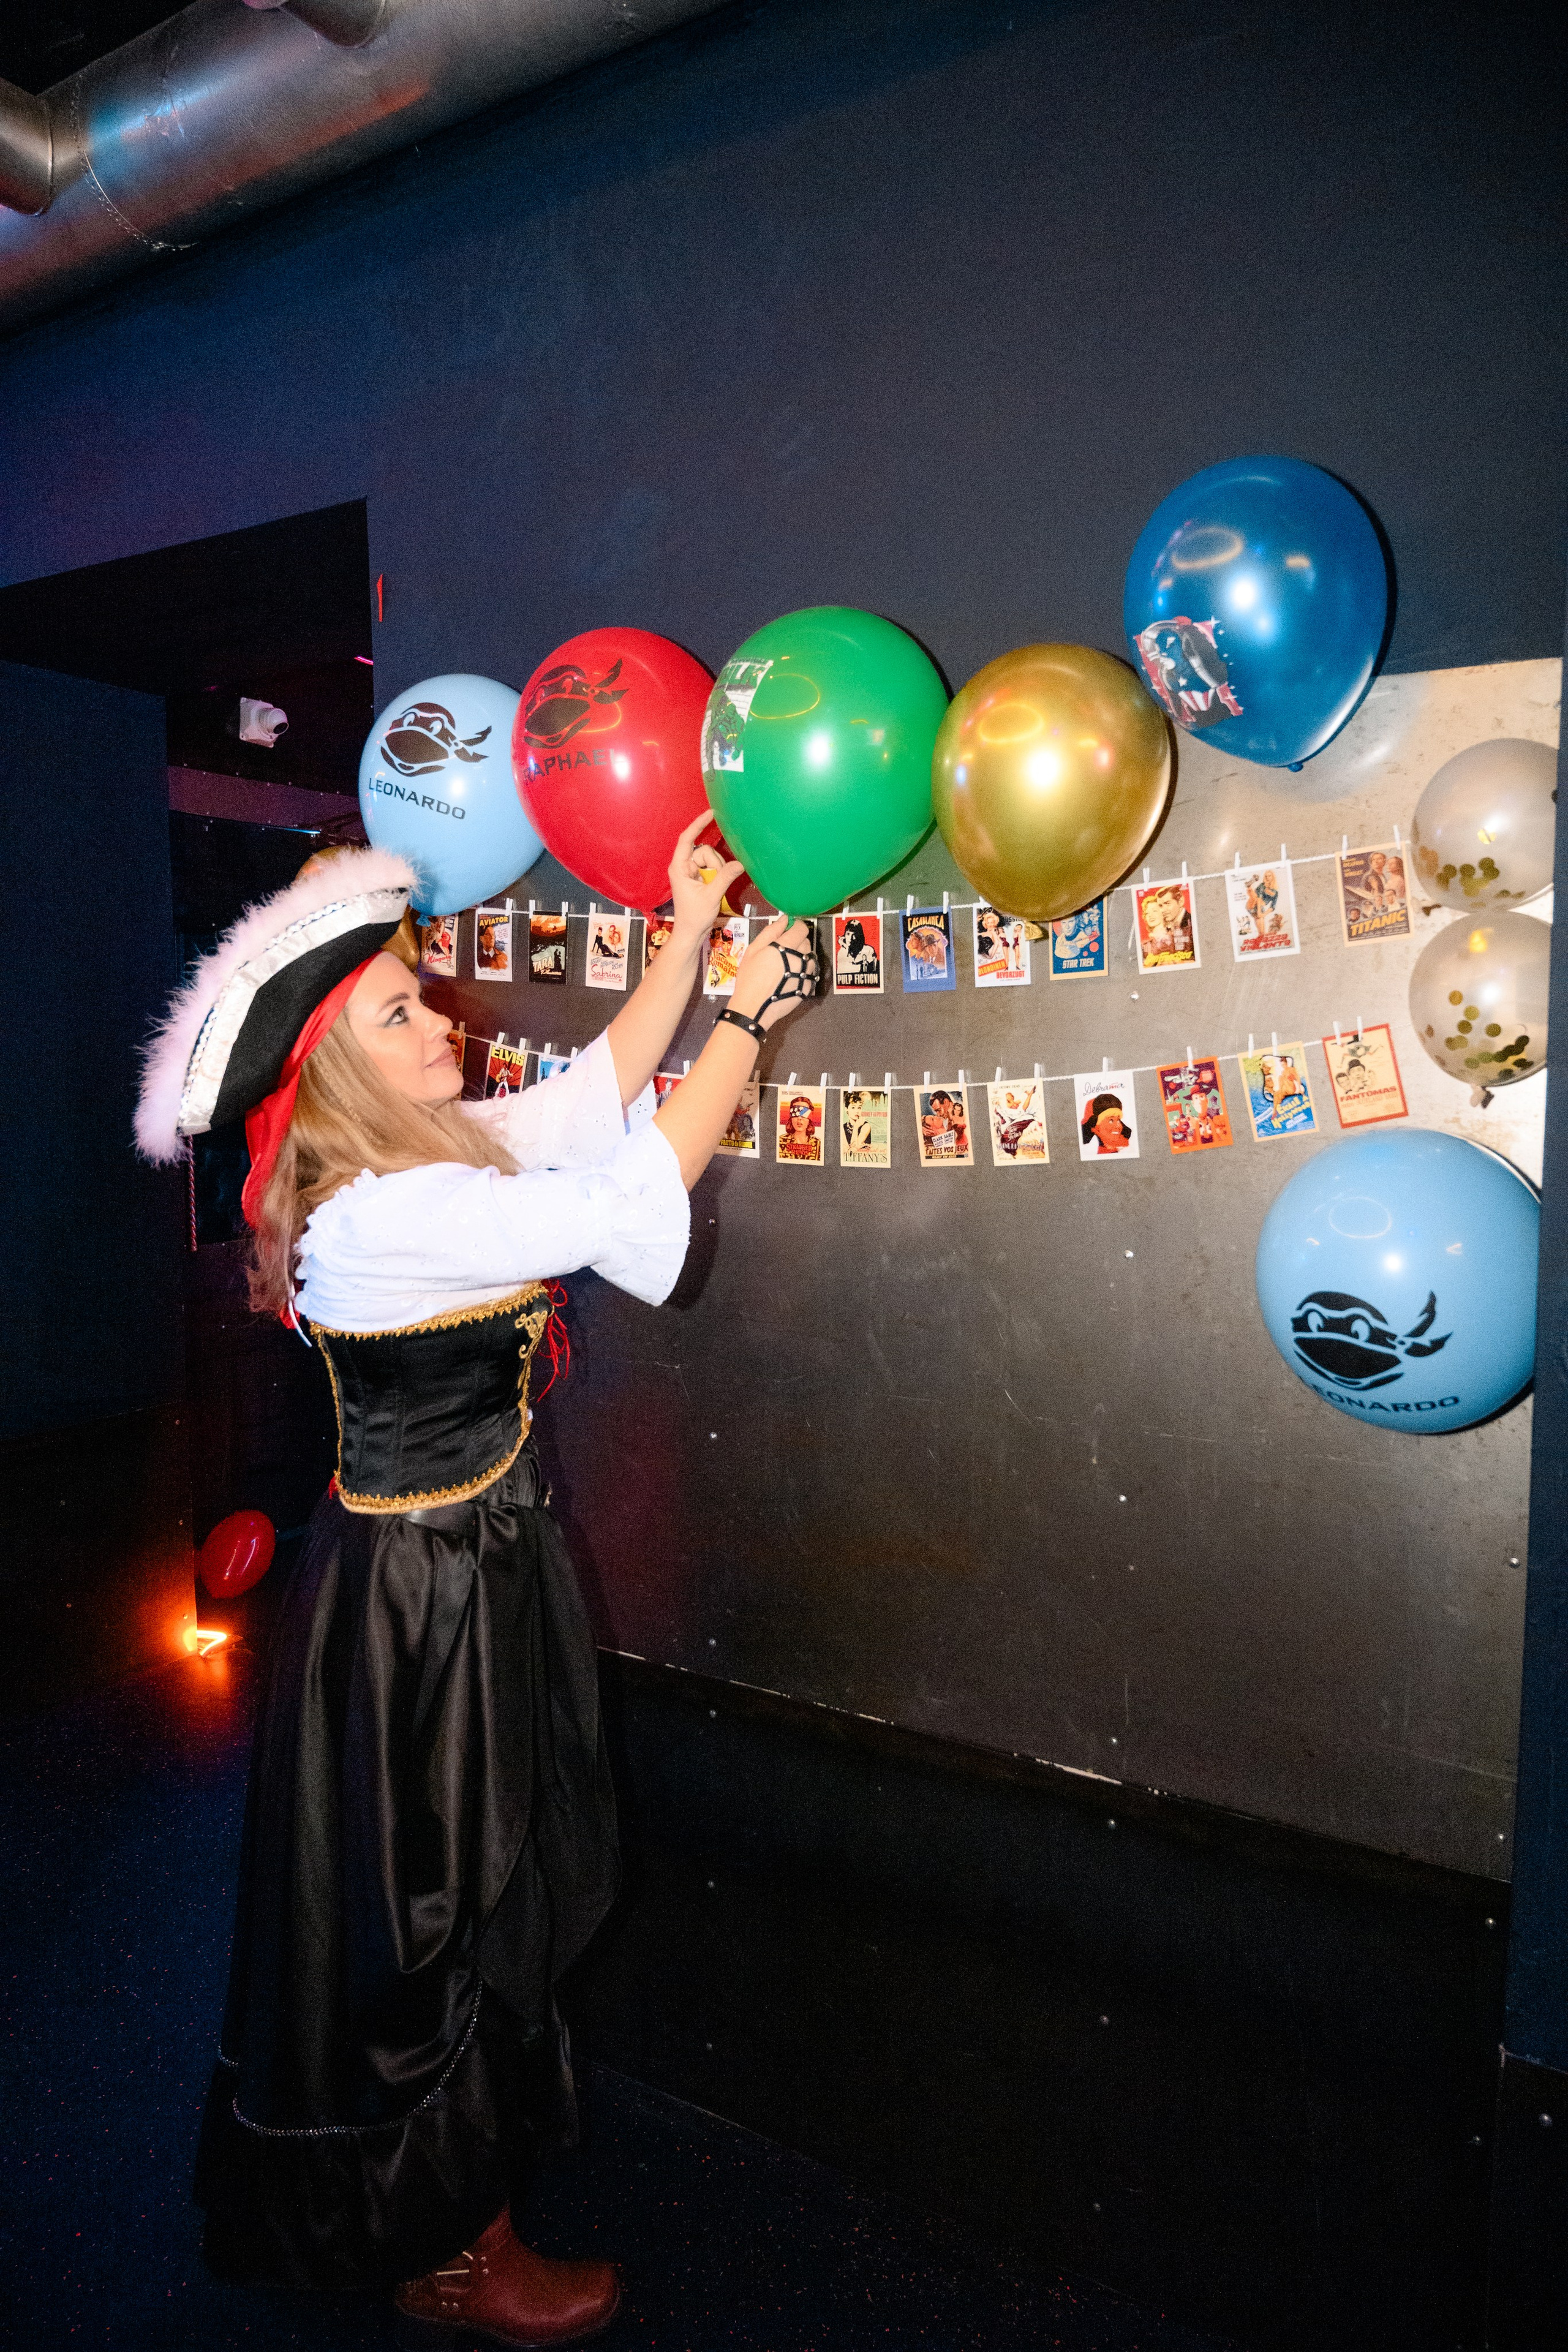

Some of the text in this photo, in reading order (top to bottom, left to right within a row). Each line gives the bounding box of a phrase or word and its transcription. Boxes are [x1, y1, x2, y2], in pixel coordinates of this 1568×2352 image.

[369, 778, 466, 820] LEONARDO
[480, 916, 508, 927] AVIATOR
[908, 915, 944, 932] CASABLANCA
[1351, 910, 1406, 937] TITANIC
[532, 956, 554, 973] TARA
[978, 960, 1006, 975] BLONDINEN
[1062, 957, 1095, 969] STAR TREK
[590, 964, 623, 979] Sabrina
[837, 973, 878, 985] PULP FICTION
[491, 1046, 526, 1066] ELVIS
[955, 1144, 968, 1153] JEUX
[1310, 1383, 1460, 1413] EONARDO
